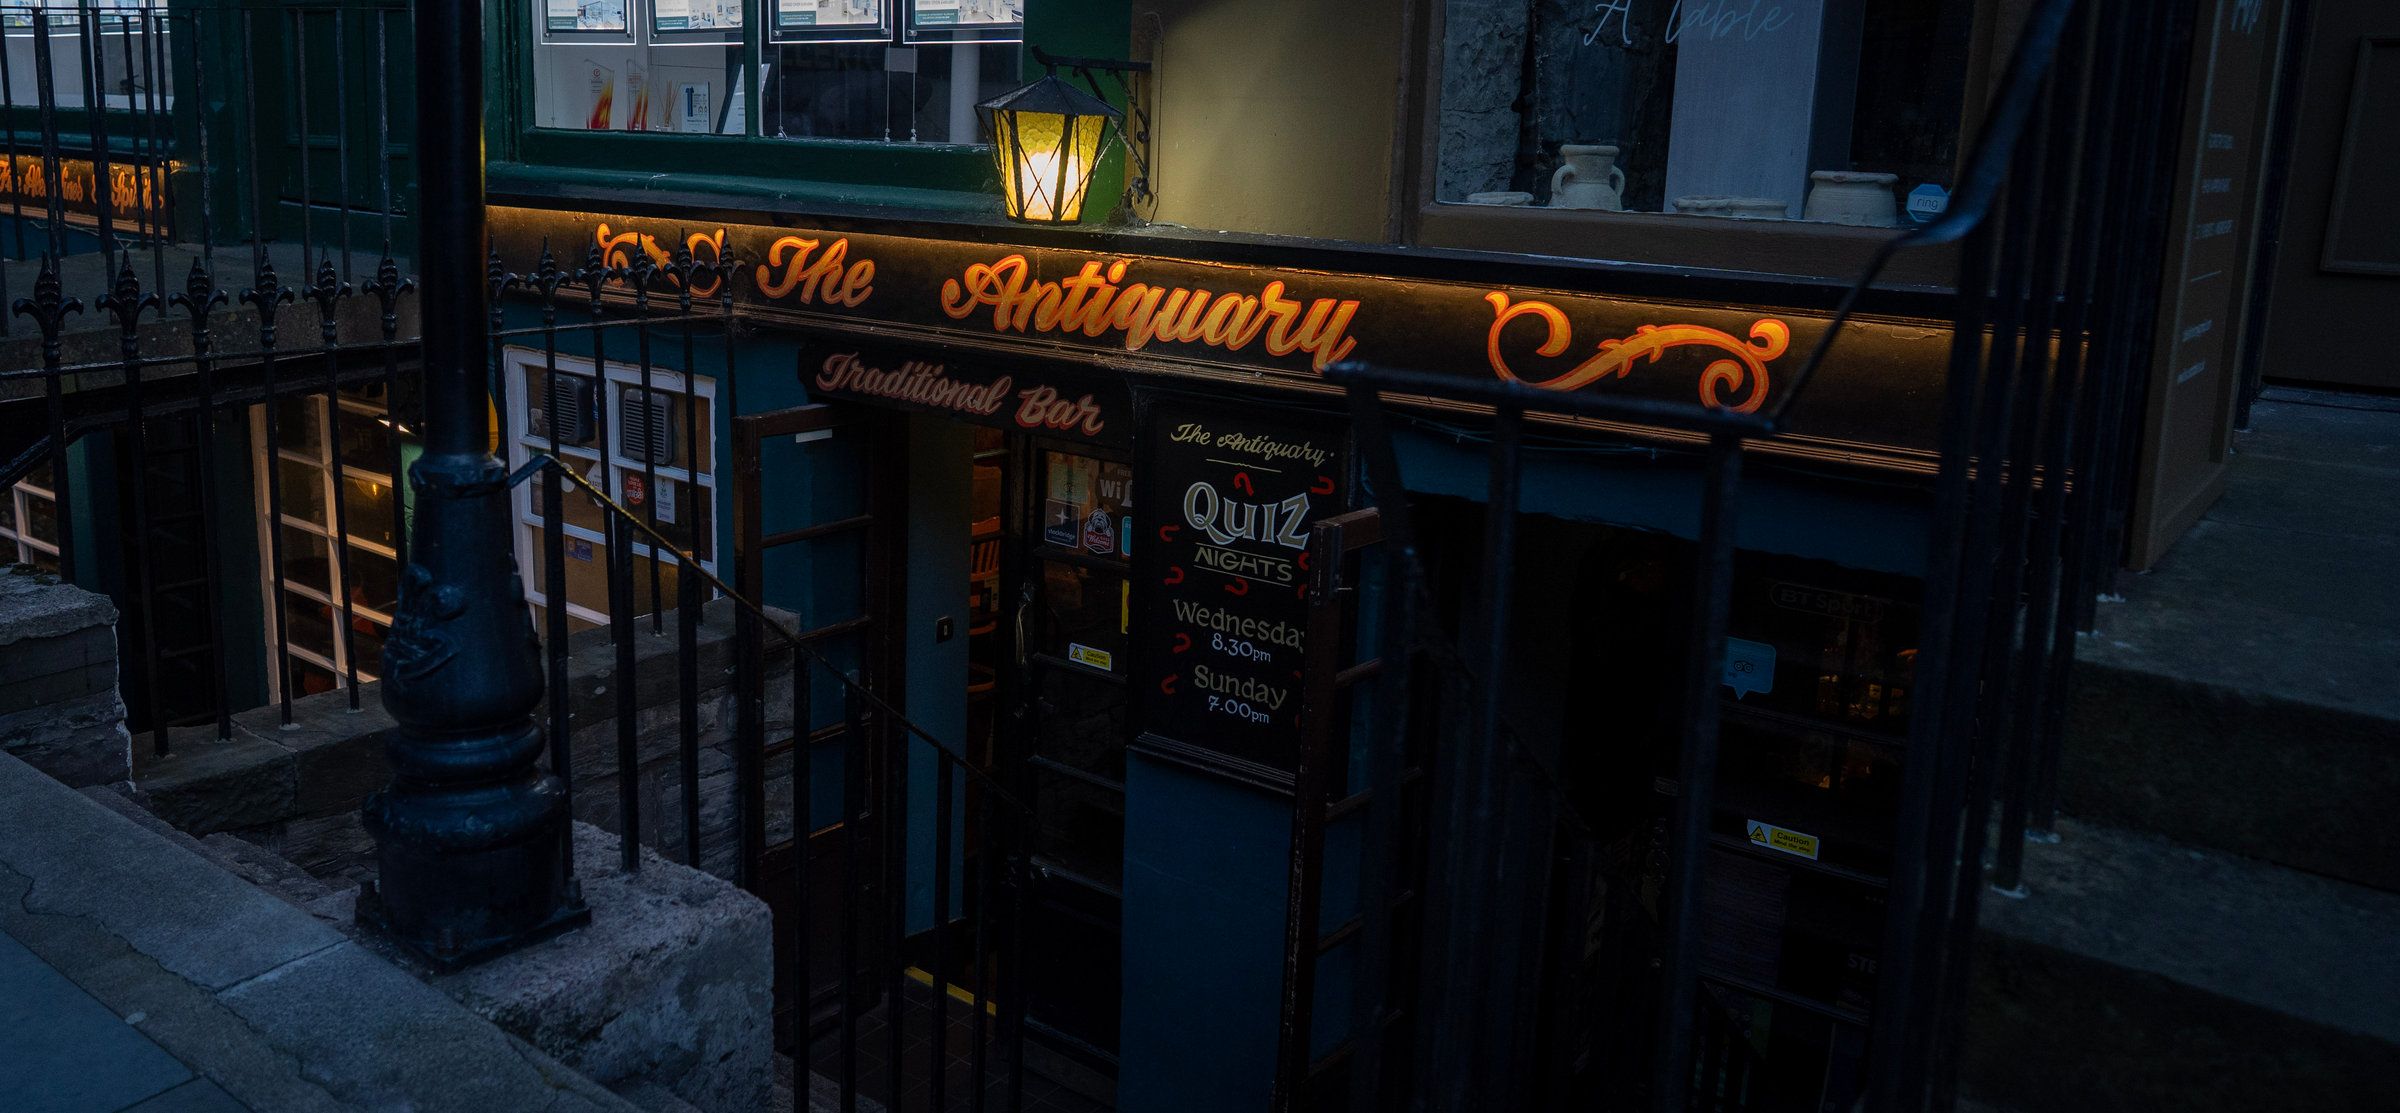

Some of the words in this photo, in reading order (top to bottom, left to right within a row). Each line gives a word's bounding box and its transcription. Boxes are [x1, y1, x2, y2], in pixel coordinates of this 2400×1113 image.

[23, 163, 50, 199] Ale
[1916, 198, 1938, 211] ring
[755, 235, 877, 309] The
[940, 253, 1361, 374] Antiquary
[815, 351, 1013, 416] Traditional
[1014, 383, 1105, 437] Bar
[1170, 423, 1211, 446] The
[1217, 432, 1326, 467] Antiquary
[1194, 546, 1293, 583] NIGHTS
[1780, 588, 1811, 604] BT
[1172, 598, 1305, 654] Wednesda
[1211, 632, 1271, 663] 8.30pm
[1194, 664, 1287, 710] Sunday
[1208, 695, 1270, 724] 7.00pm
[1777, 831, 1809, 846] Caution
